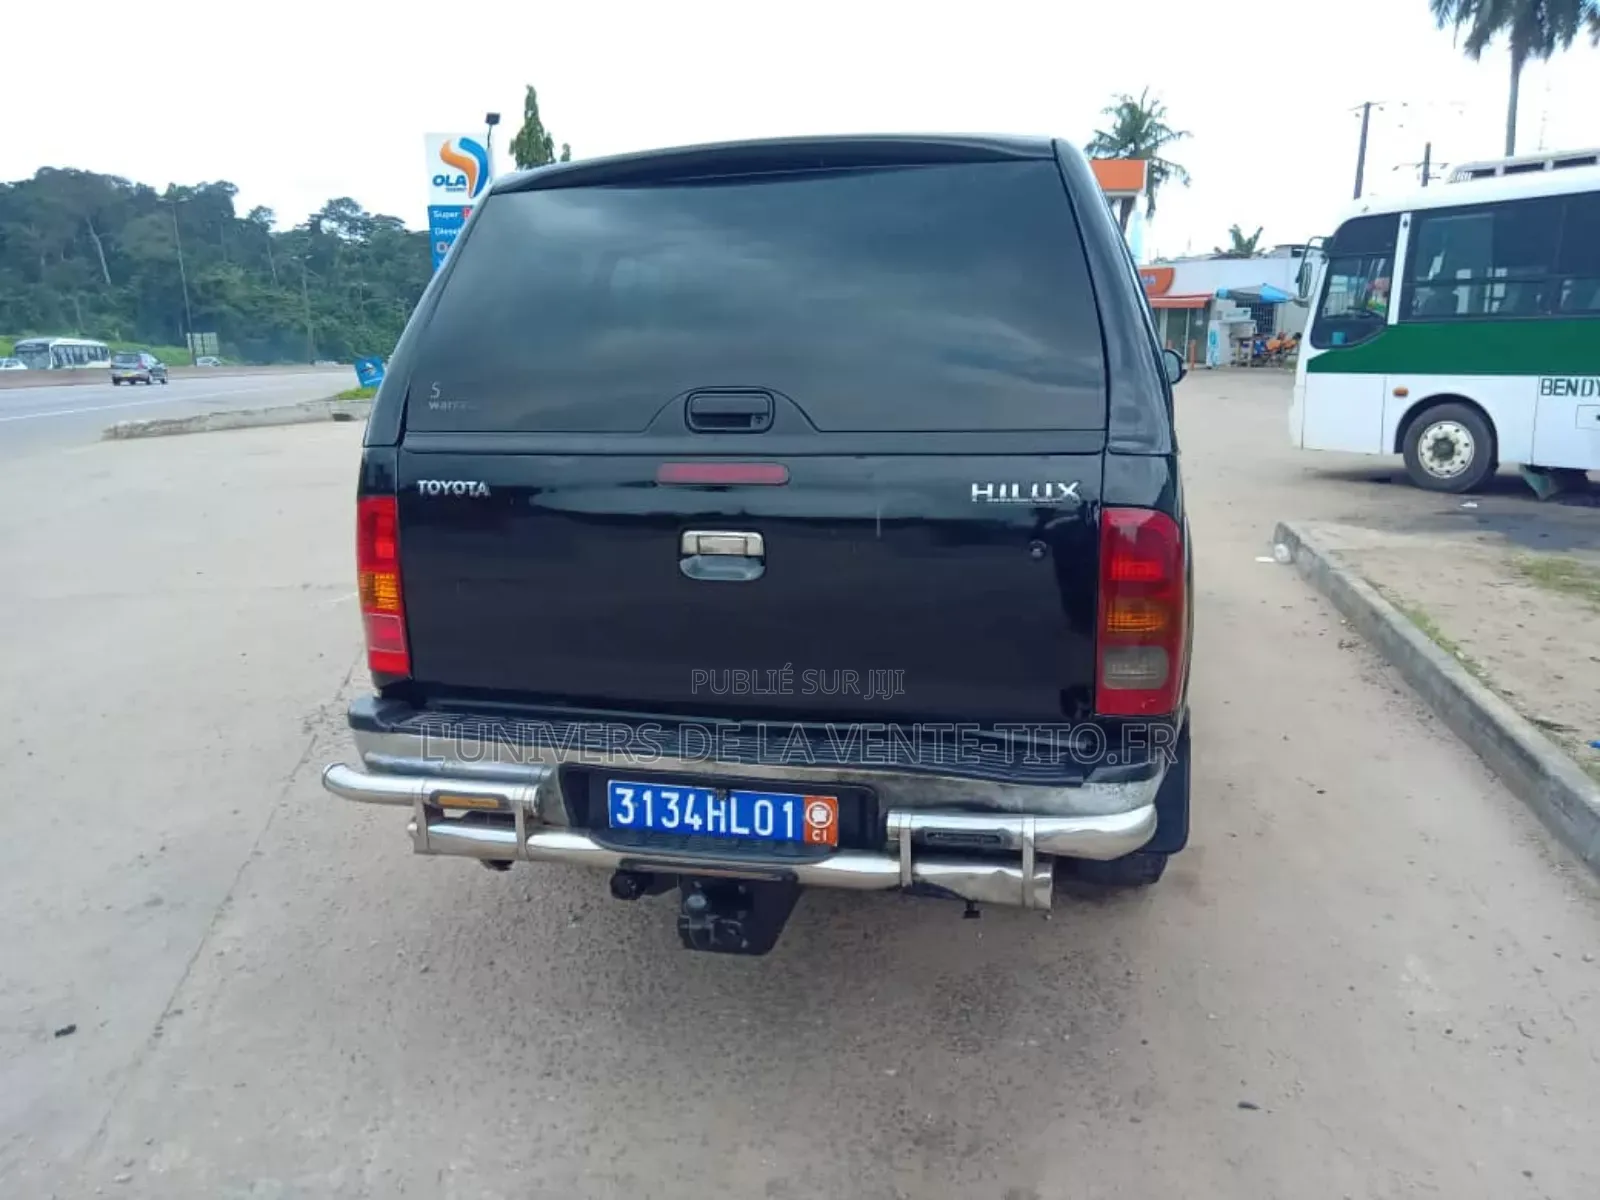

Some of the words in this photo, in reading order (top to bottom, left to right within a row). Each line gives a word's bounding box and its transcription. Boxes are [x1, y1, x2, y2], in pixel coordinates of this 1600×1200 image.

[432, 174, 467, 187] OLA
[432, 210, 459, 220] Super
[417, 480, 491, 498] TOYOTA
[971, 482, 1080, 502] HILUX
[614, 787, 794, 838] 3134HL01
[811, 830, 828, 842] CI
